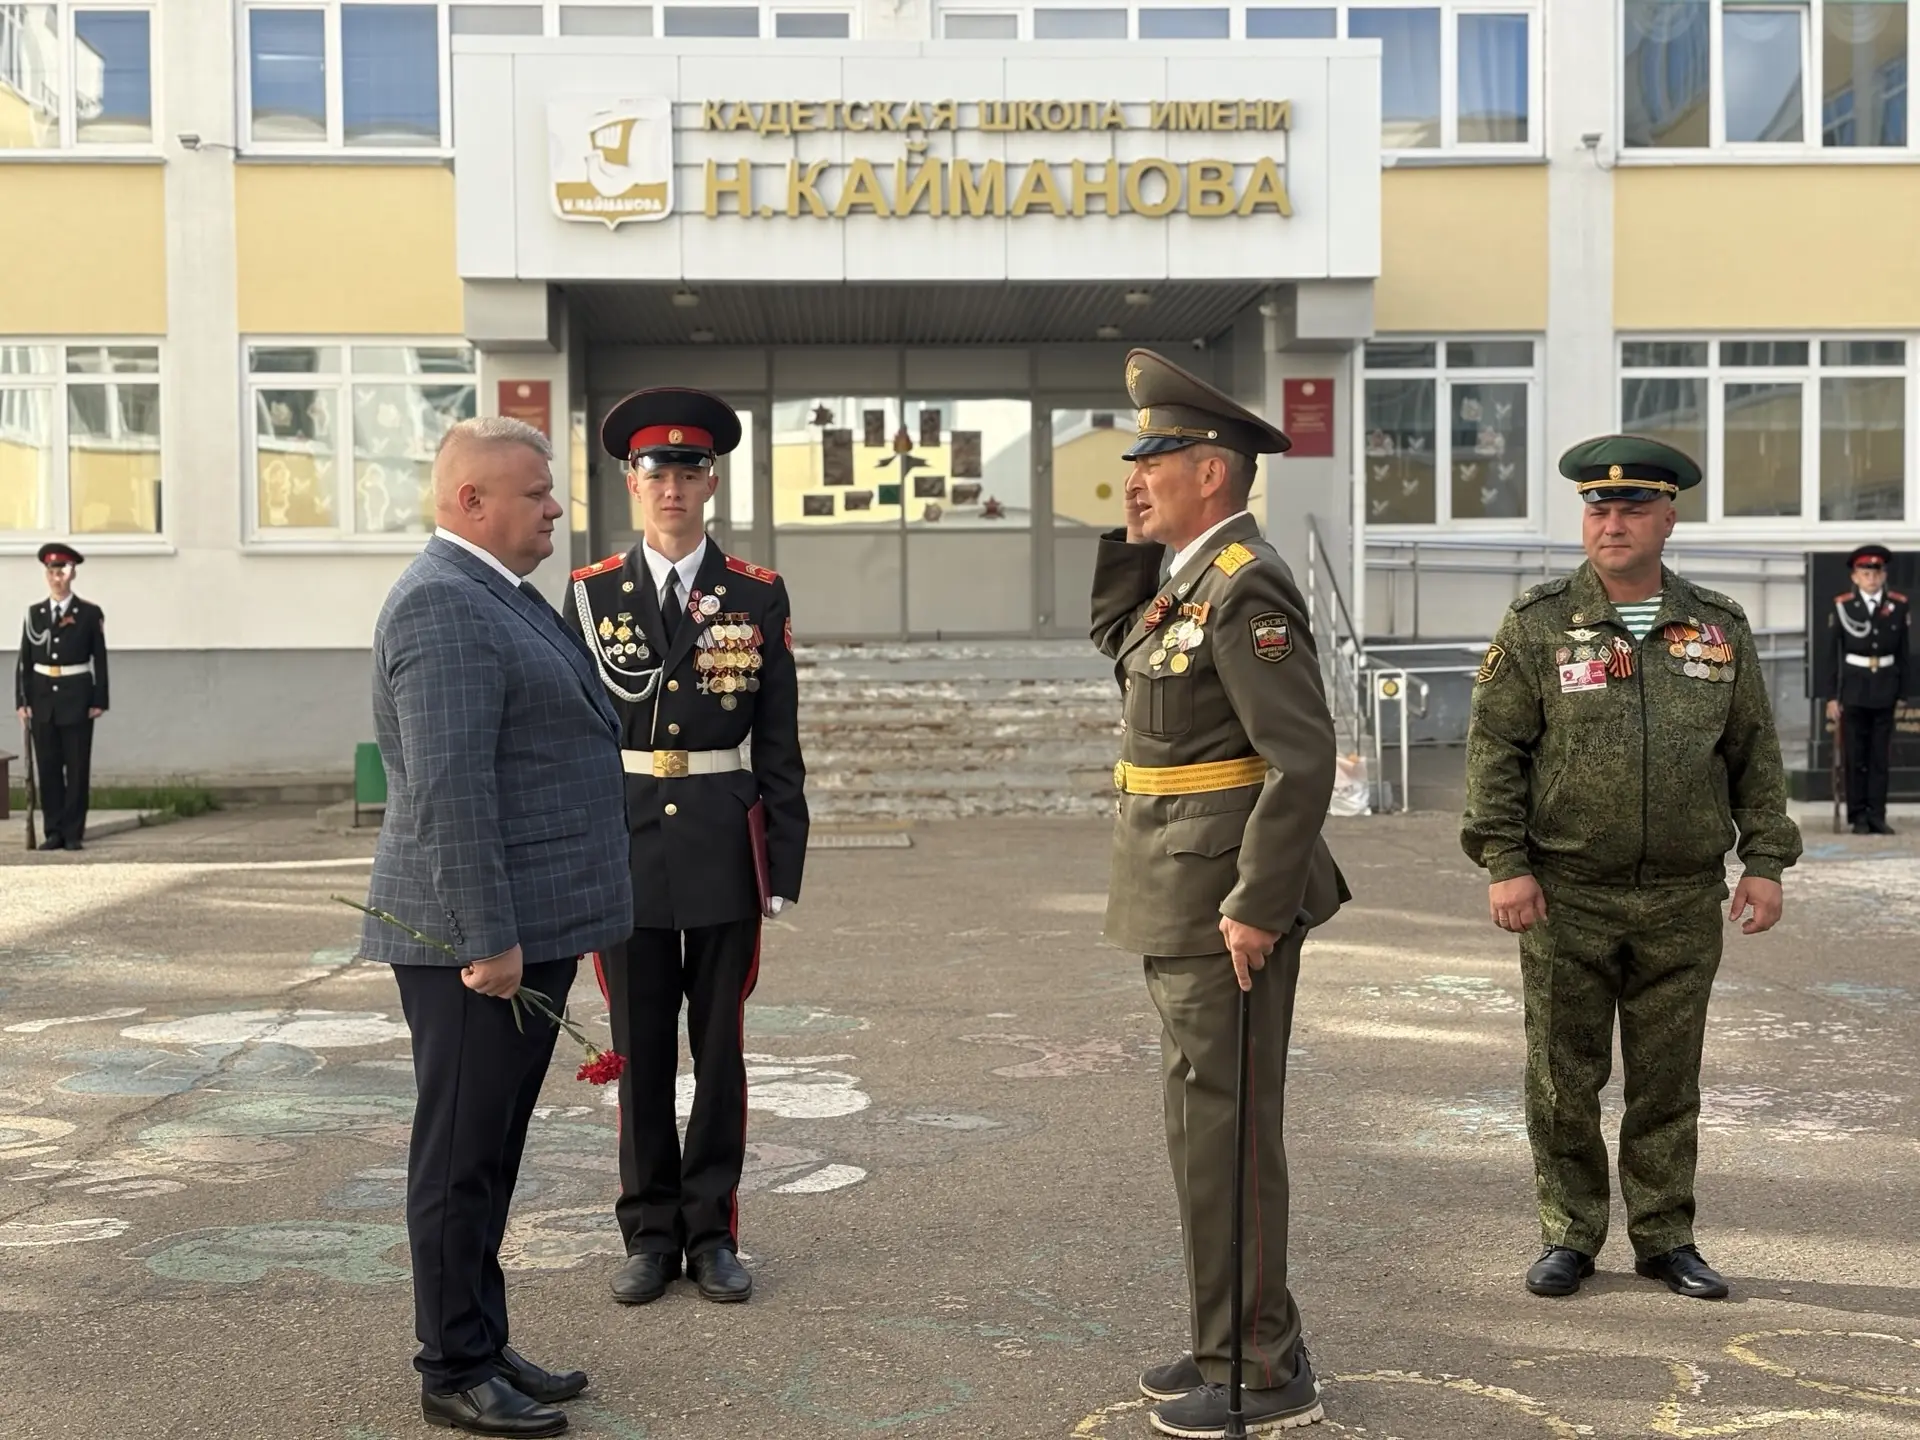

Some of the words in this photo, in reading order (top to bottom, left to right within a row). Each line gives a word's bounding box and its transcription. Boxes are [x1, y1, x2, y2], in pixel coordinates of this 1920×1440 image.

[702, 99, 957, 138] КАДЕТСКАЯ
[978, 100, 1128, 131] ШКОЛА
[1151, 100, 1292, 131] ИМЕНИ
